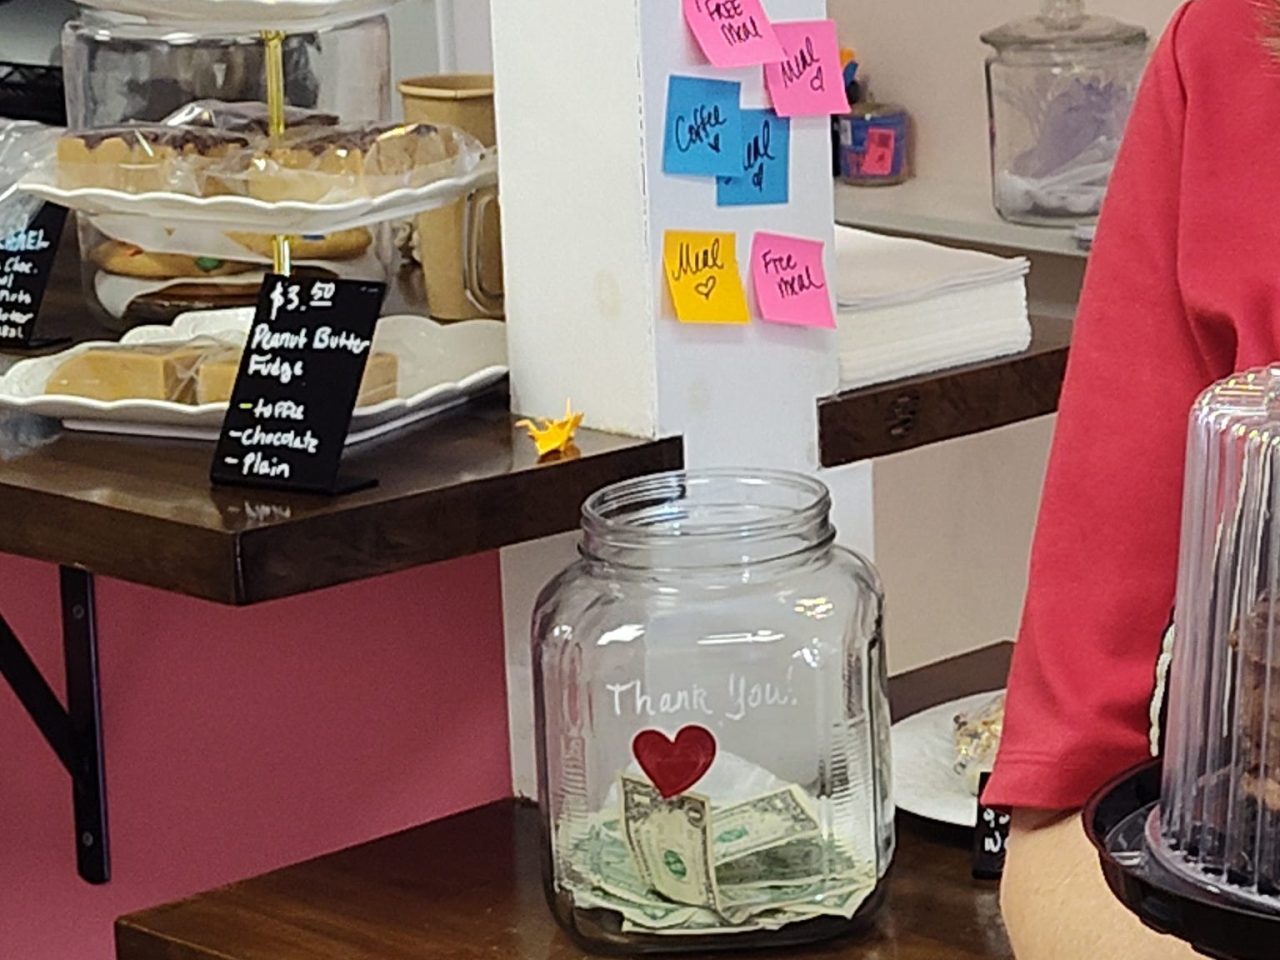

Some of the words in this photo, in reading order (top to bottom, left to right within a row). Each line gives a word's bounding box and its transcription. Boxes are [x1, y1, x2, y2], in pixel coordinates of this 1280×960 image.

[675, 105, 728, 153] Coffee
[744, 119, 776, 172] eal
[671, 238, 724, 282] Meal
[761, 250, 798, 275] Free
[251, 322, 308, 351] Peanut
[312, 326, 371, 354] Butter
[247, 353, 304, 384] Fudge
[605, 679, 714, 717] Thank
